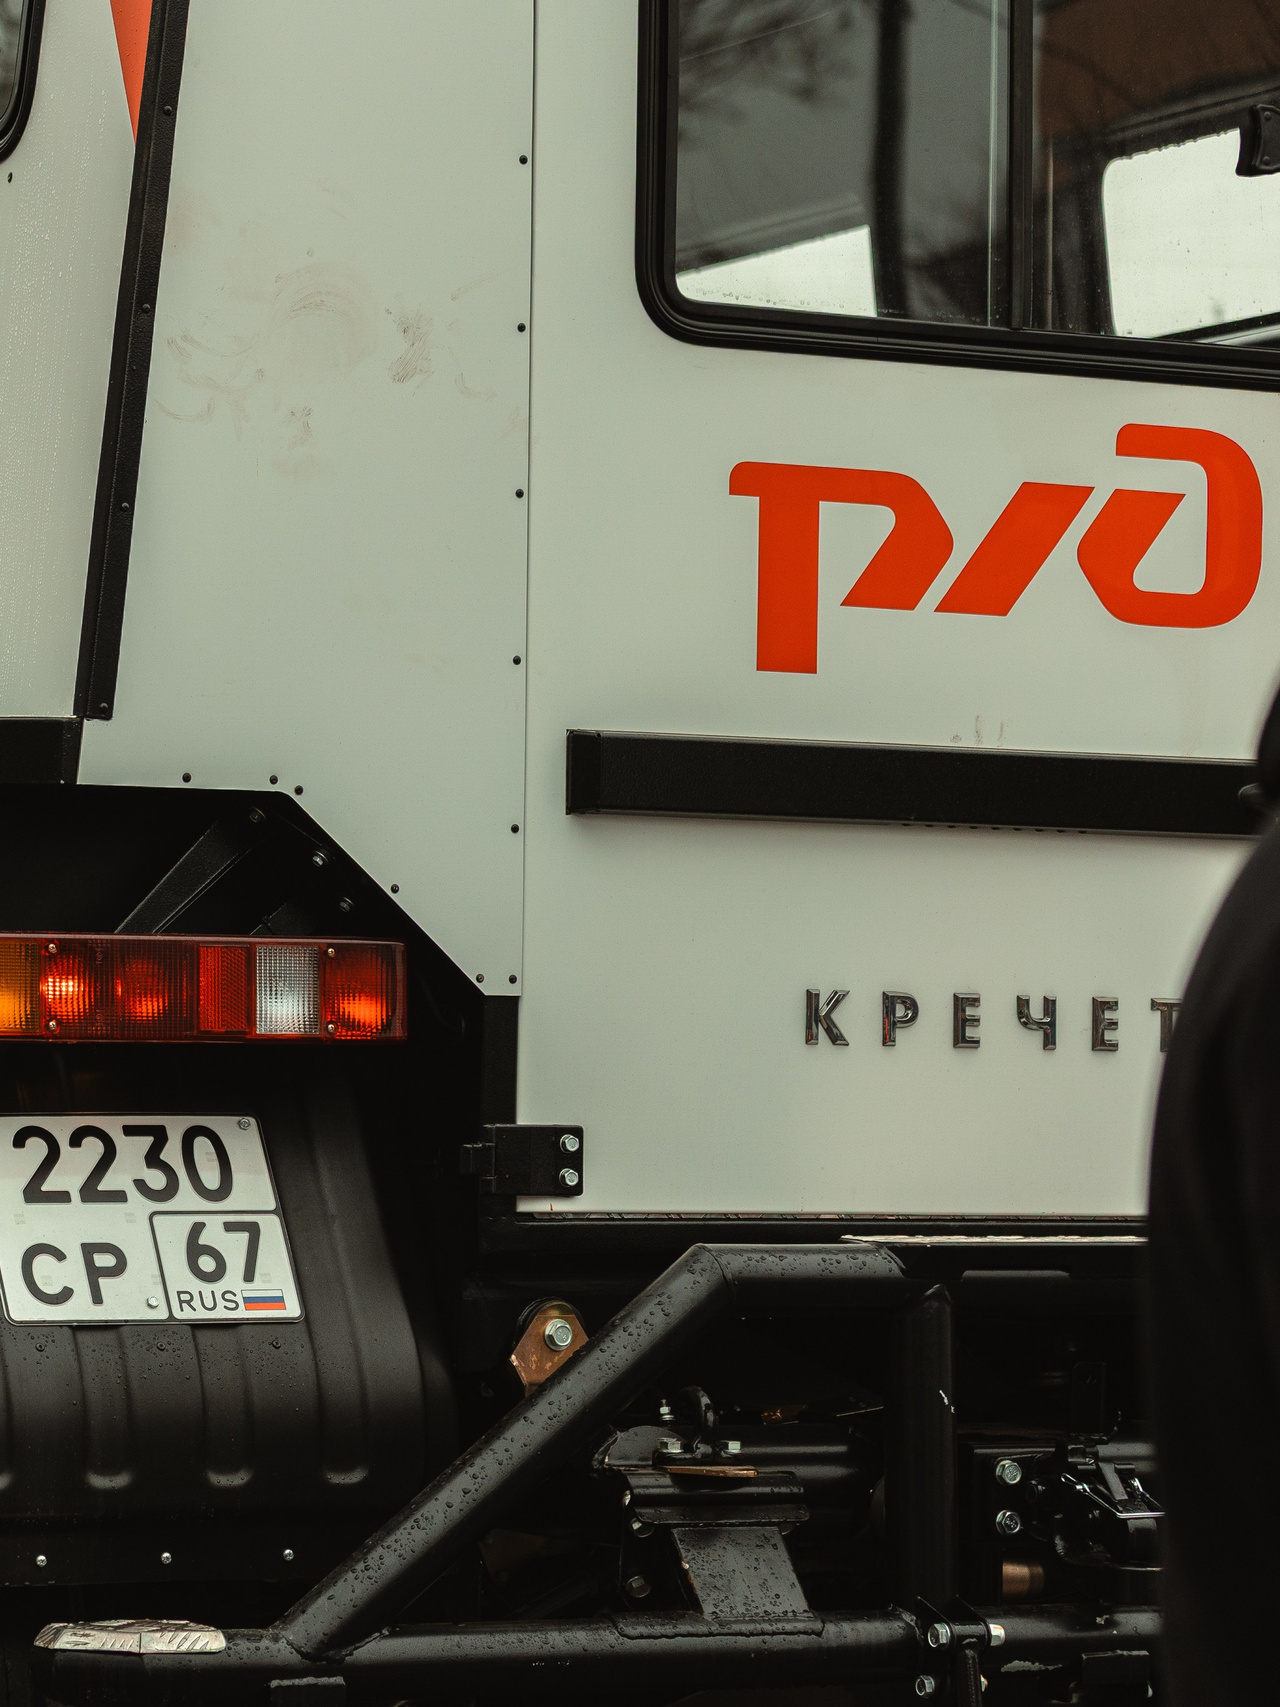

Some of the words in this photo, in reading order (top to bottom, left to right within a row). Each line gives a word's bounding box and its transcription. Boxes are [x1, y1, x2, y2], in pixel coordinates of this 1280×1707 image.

[805, 988, 1184, 1053] КРЕЧЕТ
[12, 1124, 234, 1204] 2230
[185, 1221, 262, 1283] 67
[176, 1289, 240, 1313] RUS
